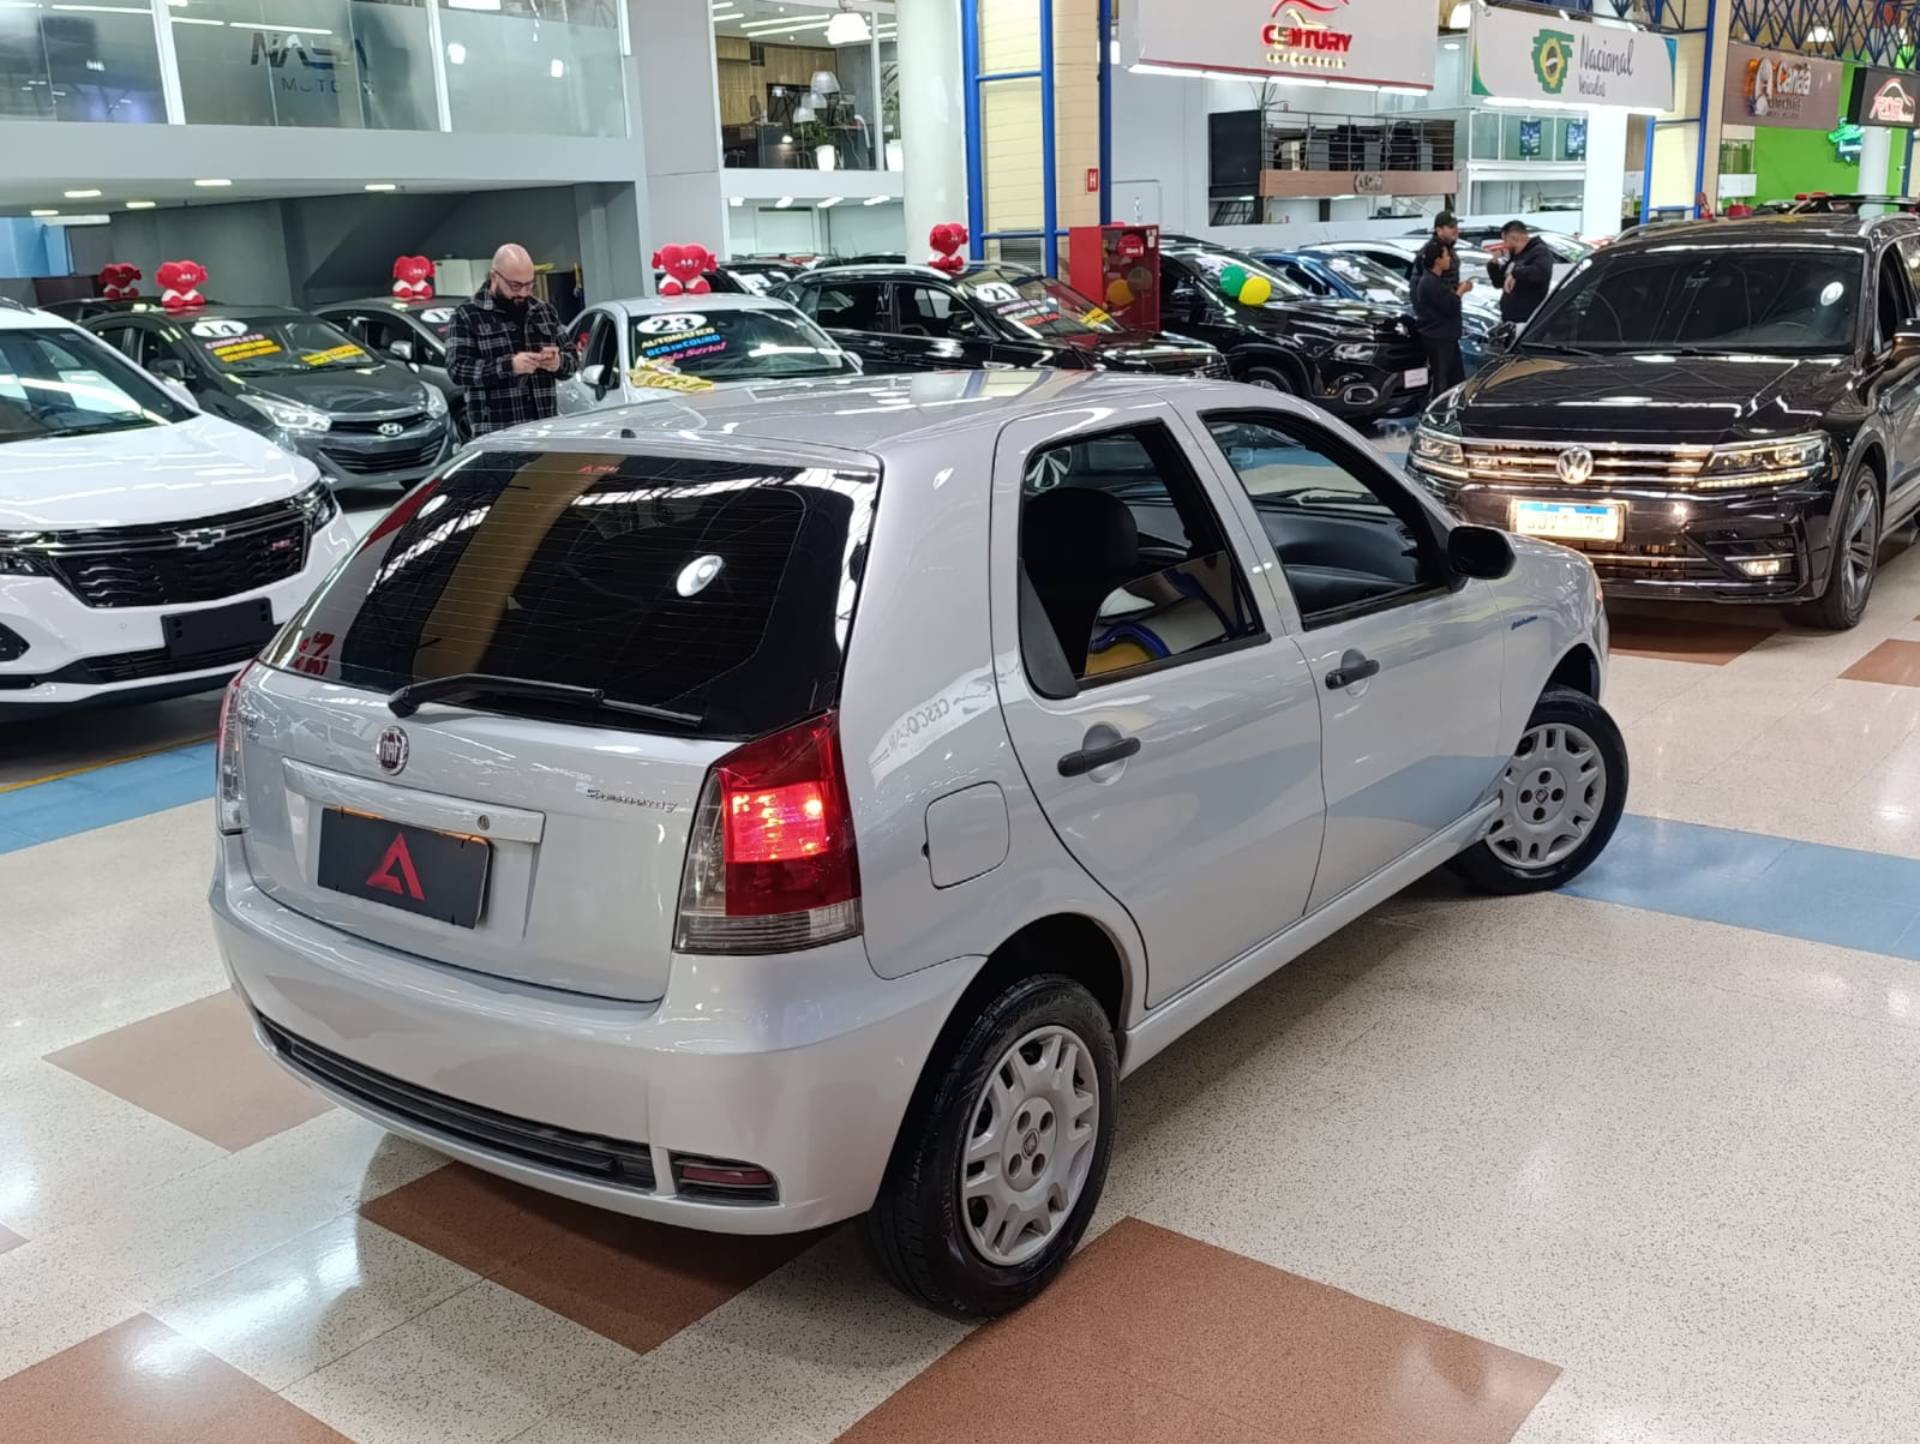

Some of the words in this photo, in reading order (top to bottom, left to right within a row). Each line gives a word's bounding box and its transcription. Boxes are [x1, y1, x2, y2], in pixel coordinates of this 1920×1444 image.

[1263, 25, 1352, 52] CENTURY
[1580, 33, 1633, 77] Nacional
[984, 286, 1016, 301] 21
[652, 317, 695, 332] 23
